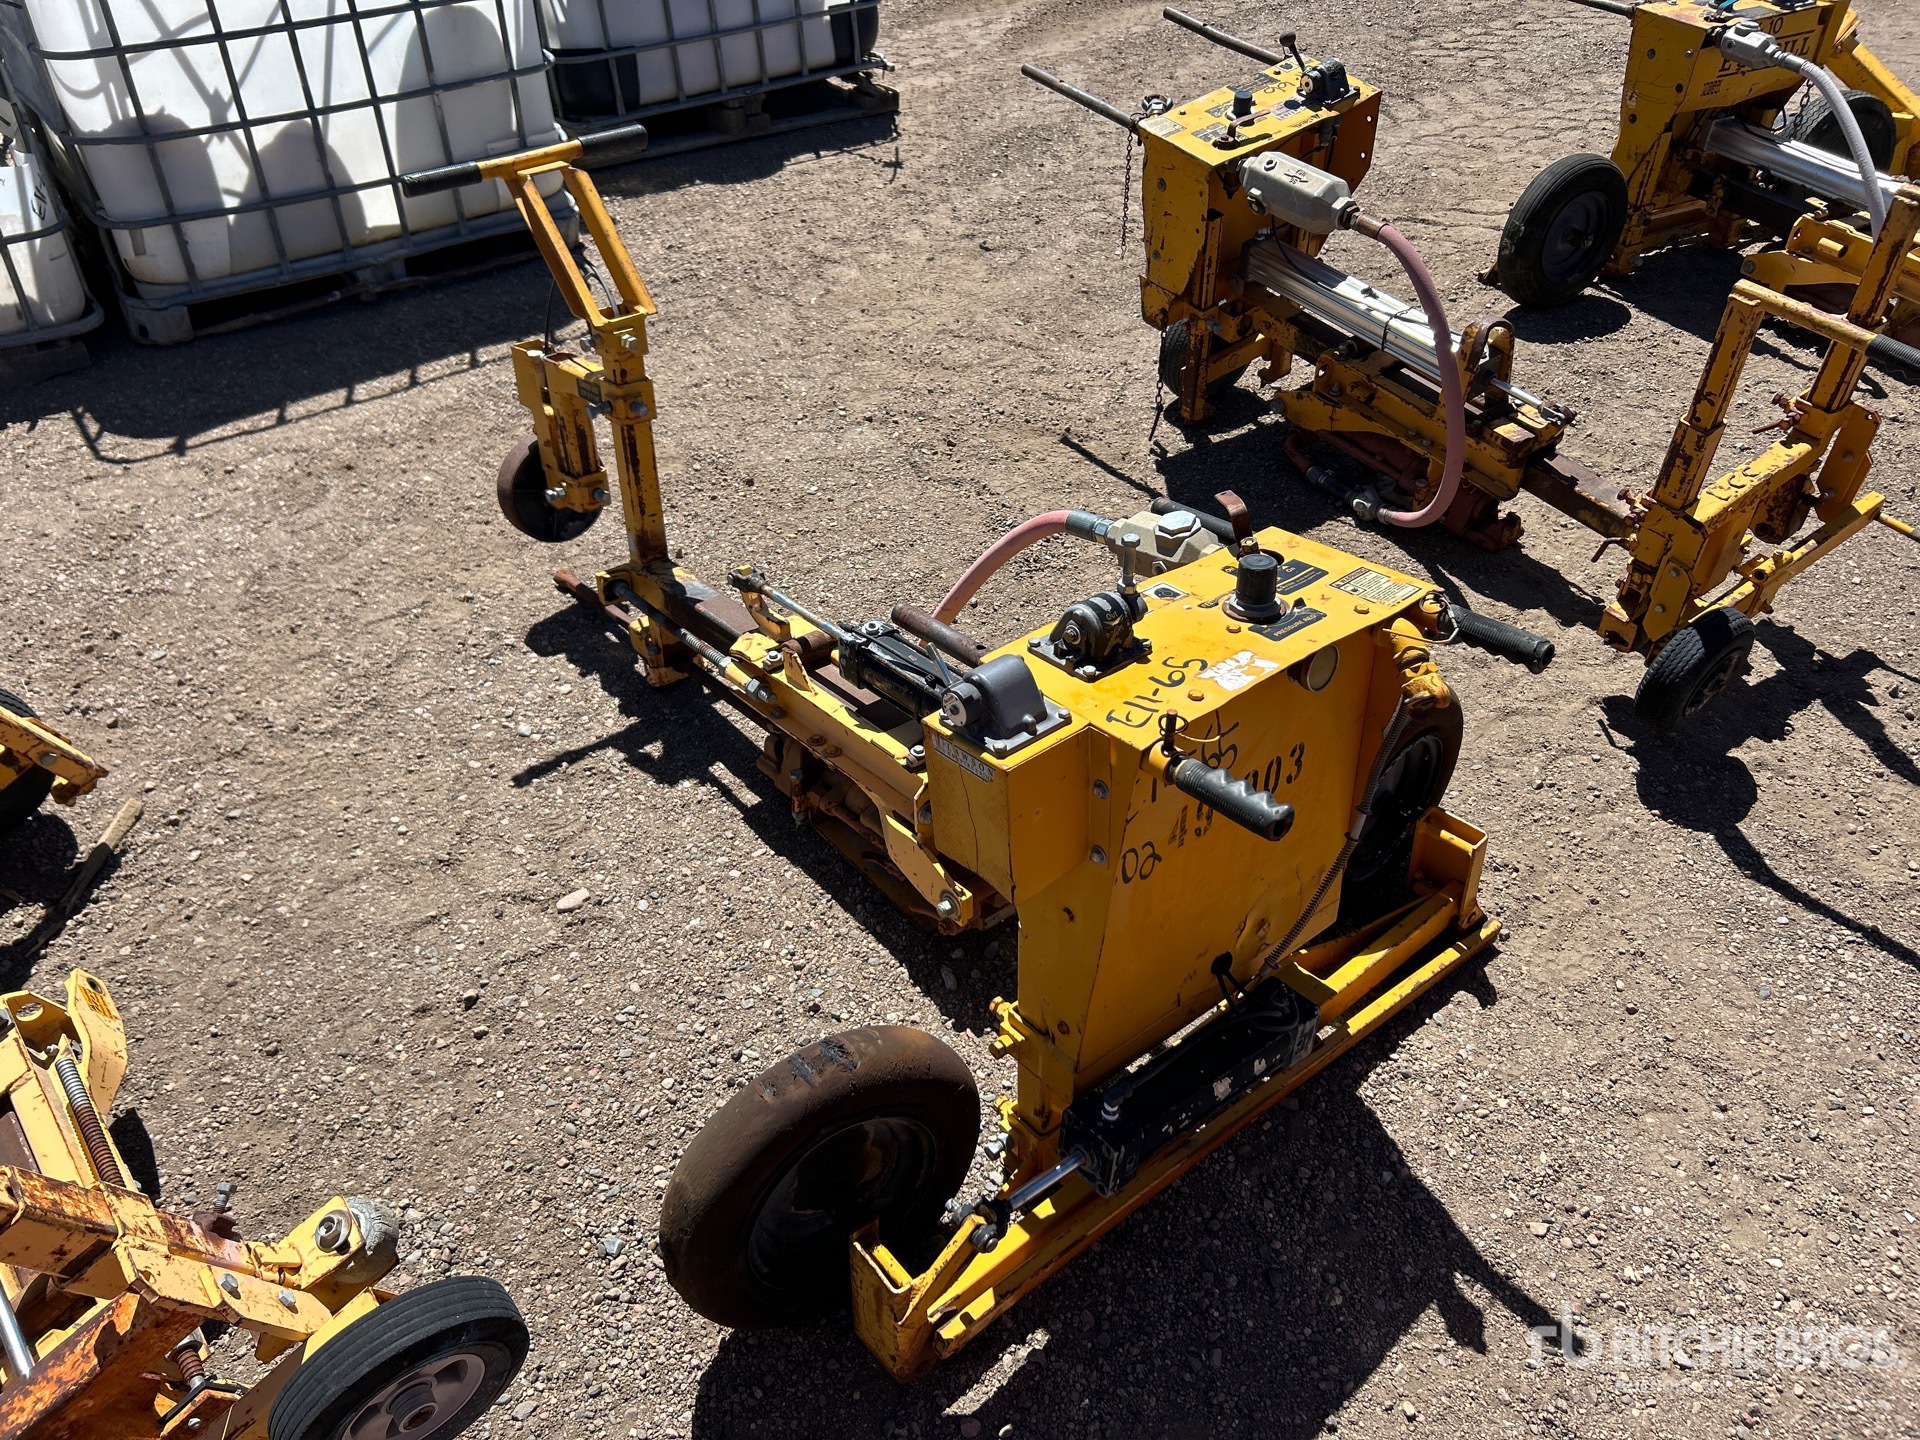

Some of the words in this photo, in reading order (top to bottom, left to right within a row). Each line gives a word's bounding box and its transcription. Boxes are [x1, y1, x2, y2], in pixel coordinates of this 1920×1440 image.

[1105, 611, 1118, 620] Out
[947, 743, 994, 778] LAWSON
[1121, 840, 1162, 884] 02
